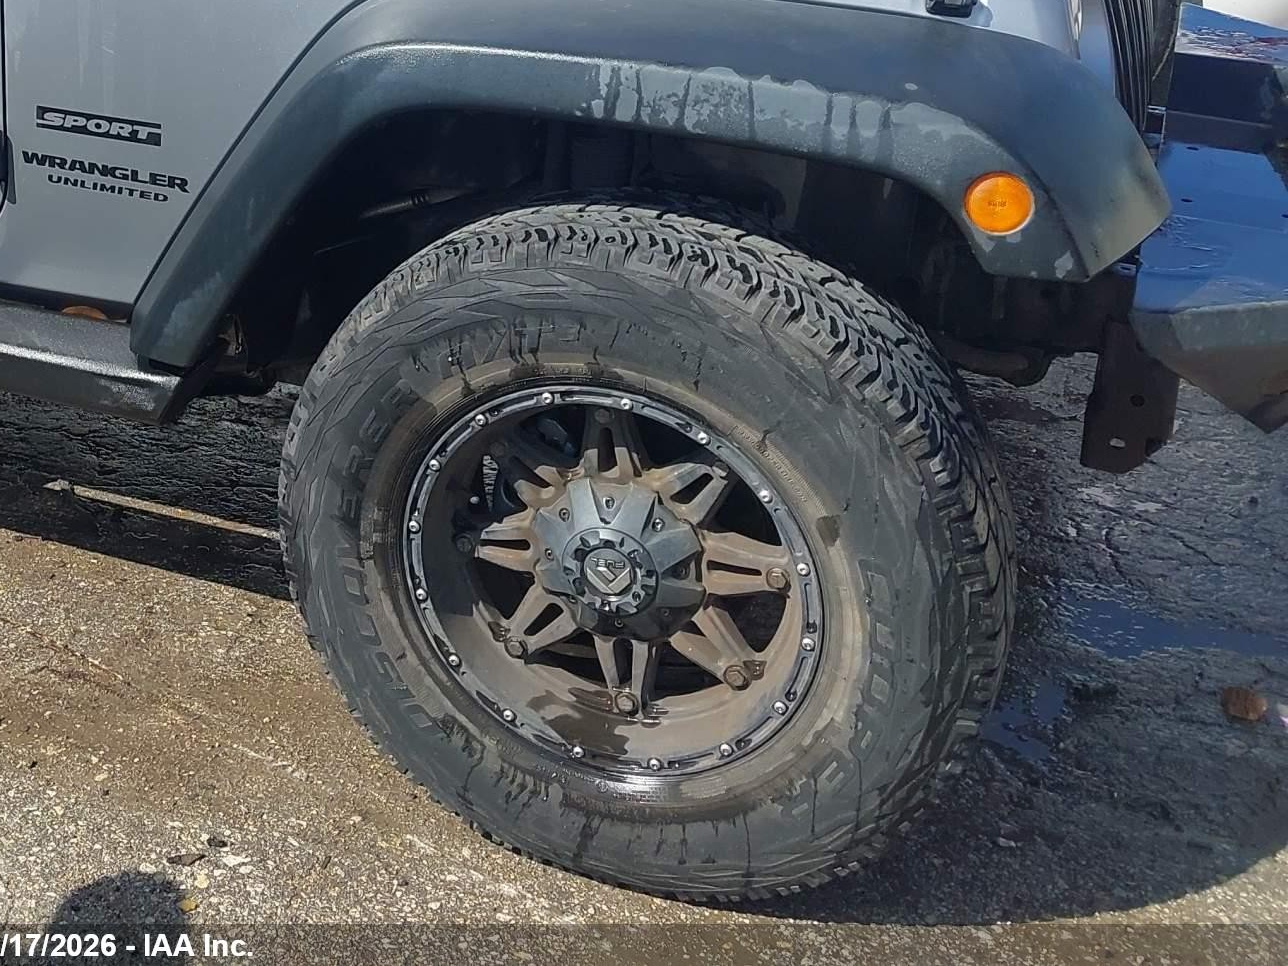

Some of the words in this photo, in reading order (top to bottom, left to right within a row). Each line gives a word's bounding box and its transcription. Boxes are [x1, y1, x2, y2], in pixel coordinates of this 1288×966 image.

[37, 109, 162, 141] SPORT
[21, 150, 190, 194] WRANGLER
[47, 174, 169, 202] UNLIMITED
[591, 557, 626, 569] FUEL
